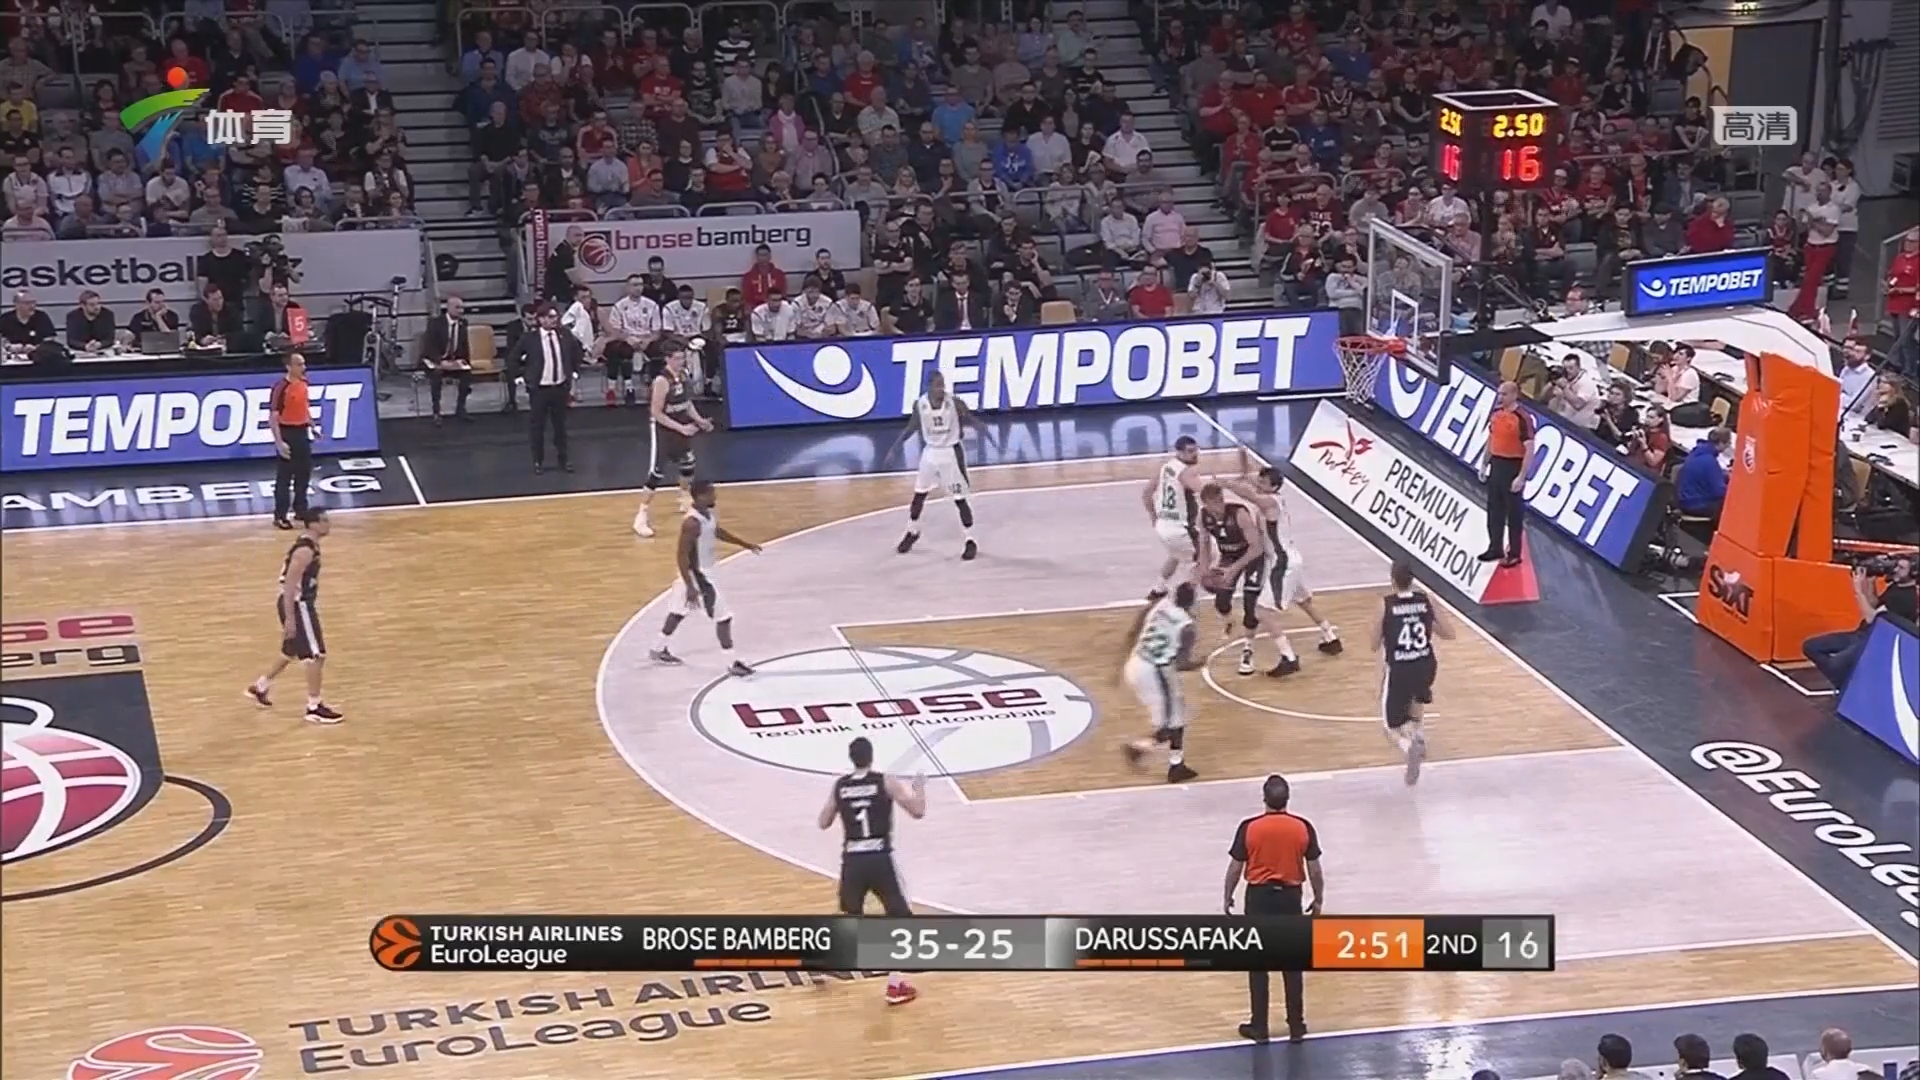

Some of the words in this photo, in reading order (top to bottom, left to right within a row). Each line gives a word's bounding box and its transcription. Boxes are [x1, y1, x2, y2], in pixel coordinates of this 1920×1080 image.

[1492, 112, 1545, 138] 2.50
[1502, 145, 1540, 181] 16
[614, 229, 693, 251] brose
[697, 223, 812, 247] bamberg
[1668, 268, 1764, 296] TEMPOBET
[294, 315, 305, 332] 5
[891, 316, 1311, 415] TEMPOBET
[1420, 364, 1640, 547] TEMOBET
[1384, 458, 1470, 532] PREMIUM
[1368, 488, 1482, 587] DESTINATION
[1398, 622, 1428, 650] 43
[731, 687, 1048, 728] brose
[750, 723, 853, 739] Technik
[860, 719, 898, 731] für
[907, 707, 1057, 727] Automobile
[855, 807, 871, 838] 1
[288, 987, 616, 1042] TURKISH
[300, 1001, 772, 1075] EuroLeague
